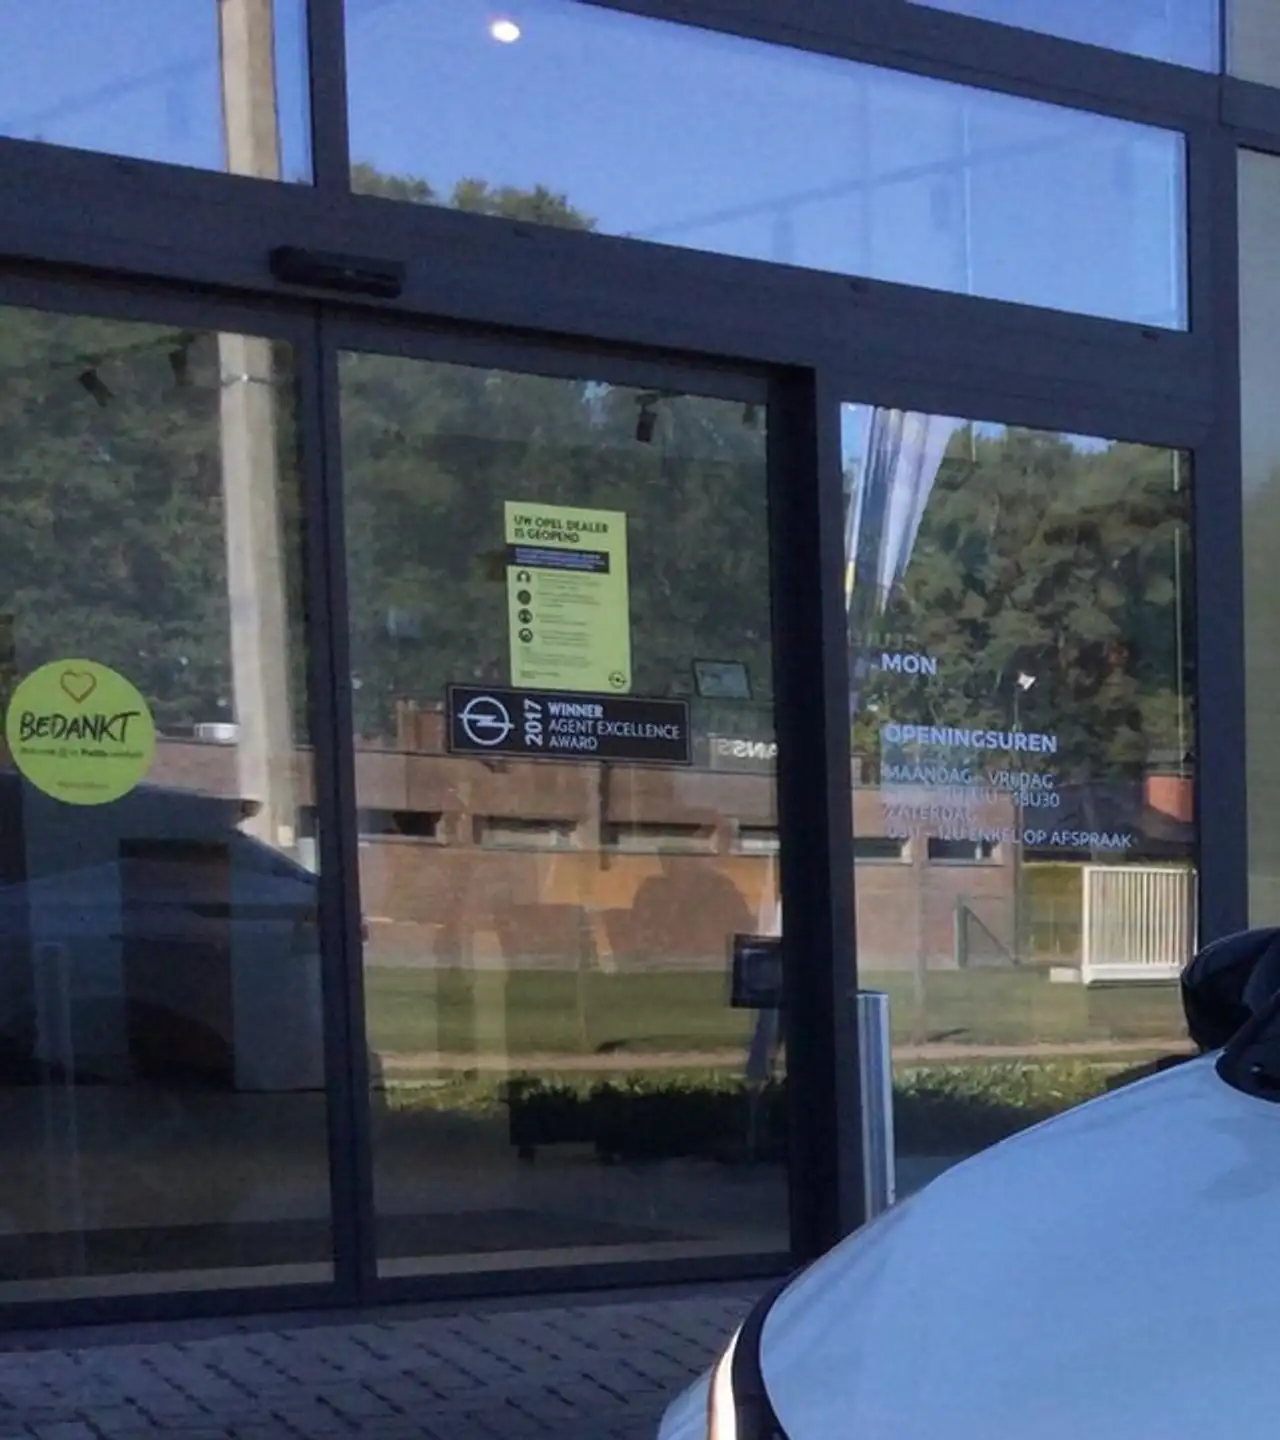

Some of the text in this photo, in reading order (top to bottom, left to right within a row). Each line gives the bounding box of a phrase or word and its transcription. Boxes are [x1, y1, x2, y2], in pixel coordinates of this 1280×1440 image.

[513, 514, 609, 534] UW OPEL DEALER
[526, 529, 581, 544] GEOPEND
[881, 652, 938, 676] MON
[547, 701, 604, 718] WINNER
[19, 710, 141, 744] BEDANKT
[525, 699, 544, 747] 2017
[548, 719, 681, 741] AGENT EXCELLENCE
[548, 735, 598, 751] AWARD
[883, 723, 1057, 753] OPENINGSUREN
[883, 764, 972, 785] MAANDAG
[1023, 829, 1049, 847] OP
[1051, 830, 1133, 850] AFSPRAAK
